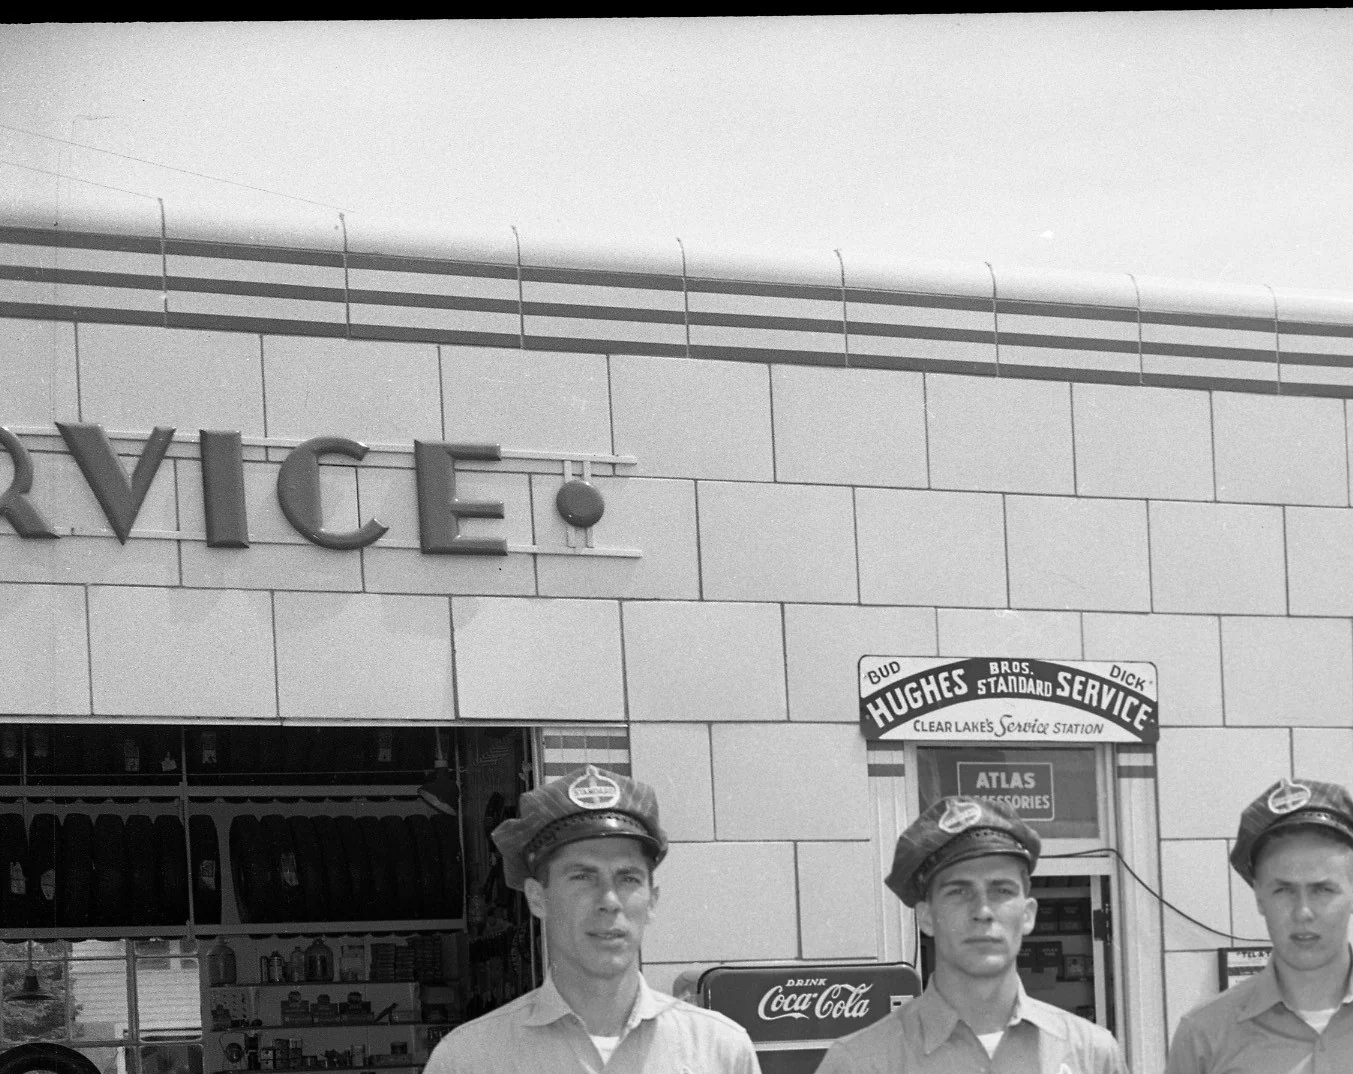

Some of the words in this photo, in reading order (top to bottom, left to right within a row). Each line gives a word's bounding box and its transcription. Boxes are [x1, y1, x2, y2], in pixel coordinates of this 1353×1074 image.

[867, 661, 901, 685] BUD
[989, 661, 1034, 675] BROS.
[1109, 664, 1147, 692] DICK
[866, 668, 968, 728] HUGHES
[977, 675, 1053, 697] STANDARD
[1056, 671, 1153, 731] SERVICE
[913, 720, 953, 733] CLEAR
[955, 718, 994, 733] LAKE'S
[994, 714, 1051, 737] Service
[1052, 722, 1104, 735] STATION
[976, 771, 1036, 789] ATLAS
[785, 978, 828, 987] DRINK
[757, 983, 873, 1021] Coca-Cola
